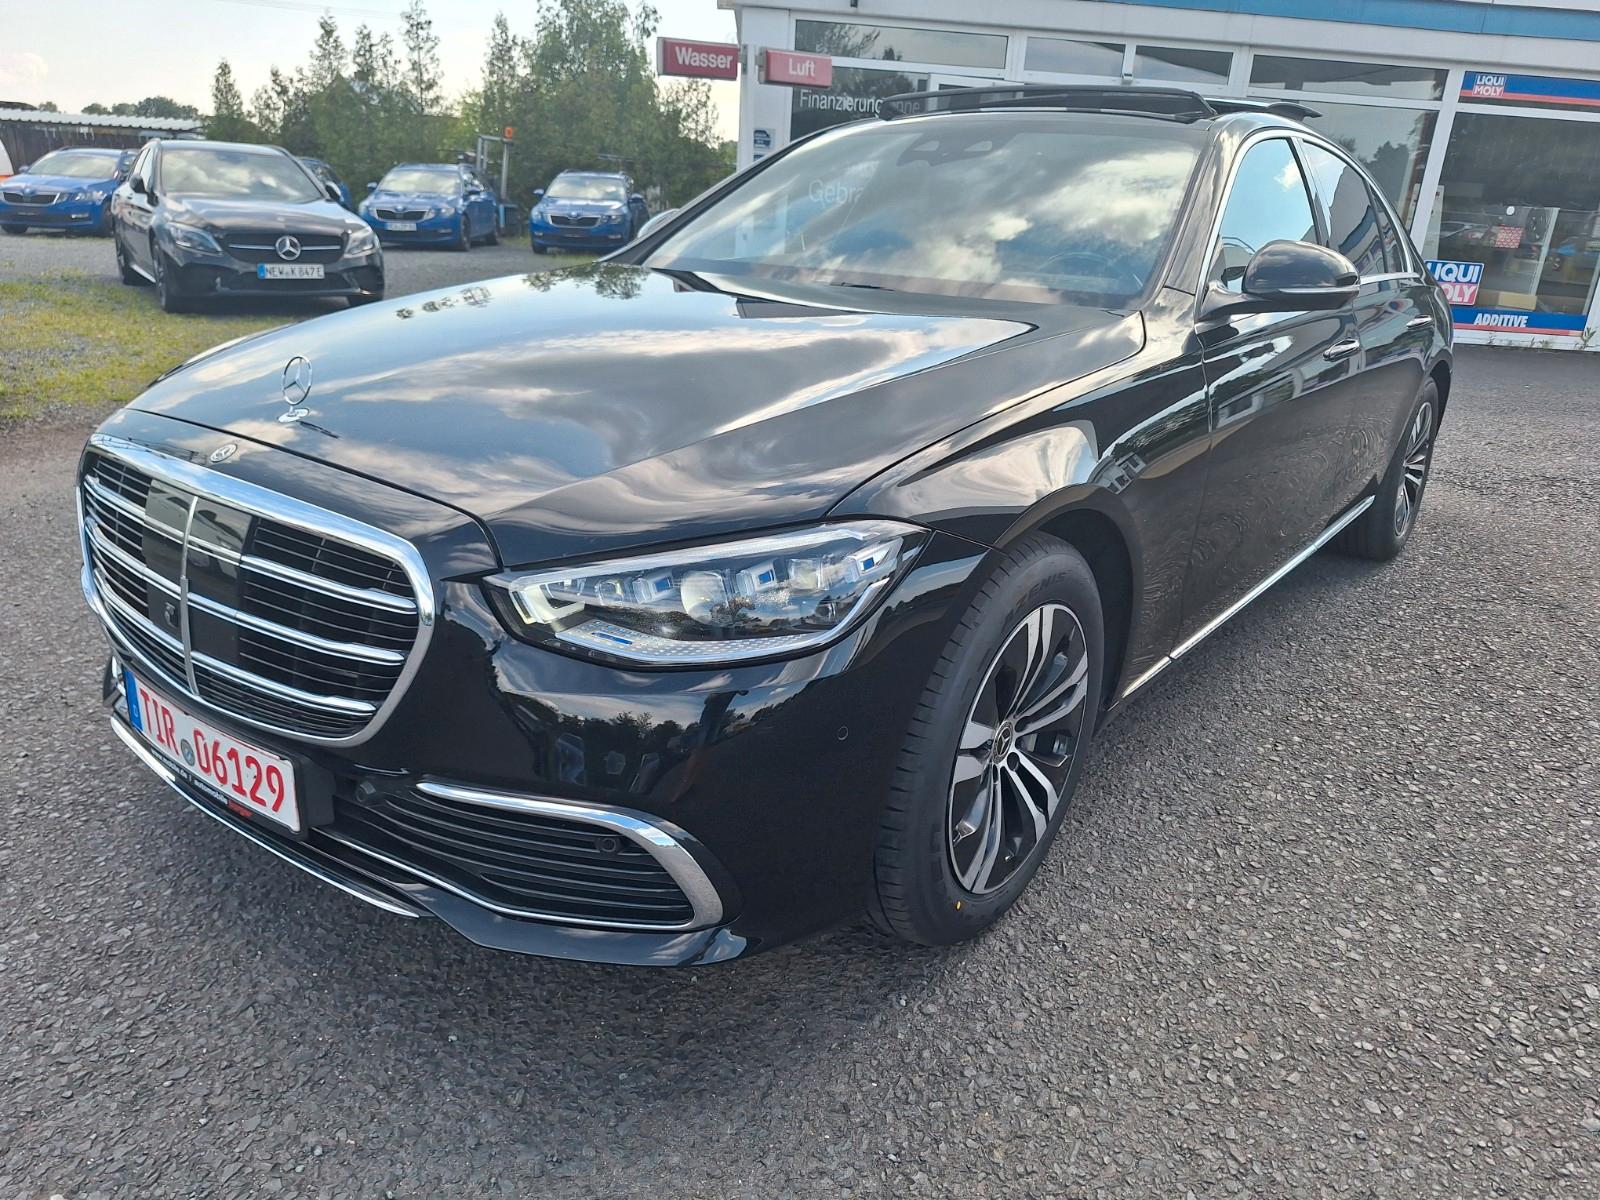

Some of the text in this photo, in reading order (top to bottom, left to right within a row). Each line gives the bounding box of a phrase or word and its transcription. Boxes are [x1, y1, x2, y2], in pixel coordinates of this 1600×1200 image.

[675, 46, 733, 69] Wasser
[789, 58, 815, 76] Luft
[1476, 75, 1504, 86] LIQUI
[1474, 85, 1504, 97] MOLY
[1441, 283, 1477, 303] OLY
[1473, 313, 1529, 328] ADDITIVE
[140, 688, 179, 756] TIR
[193, 728, 285, 813] 06129
